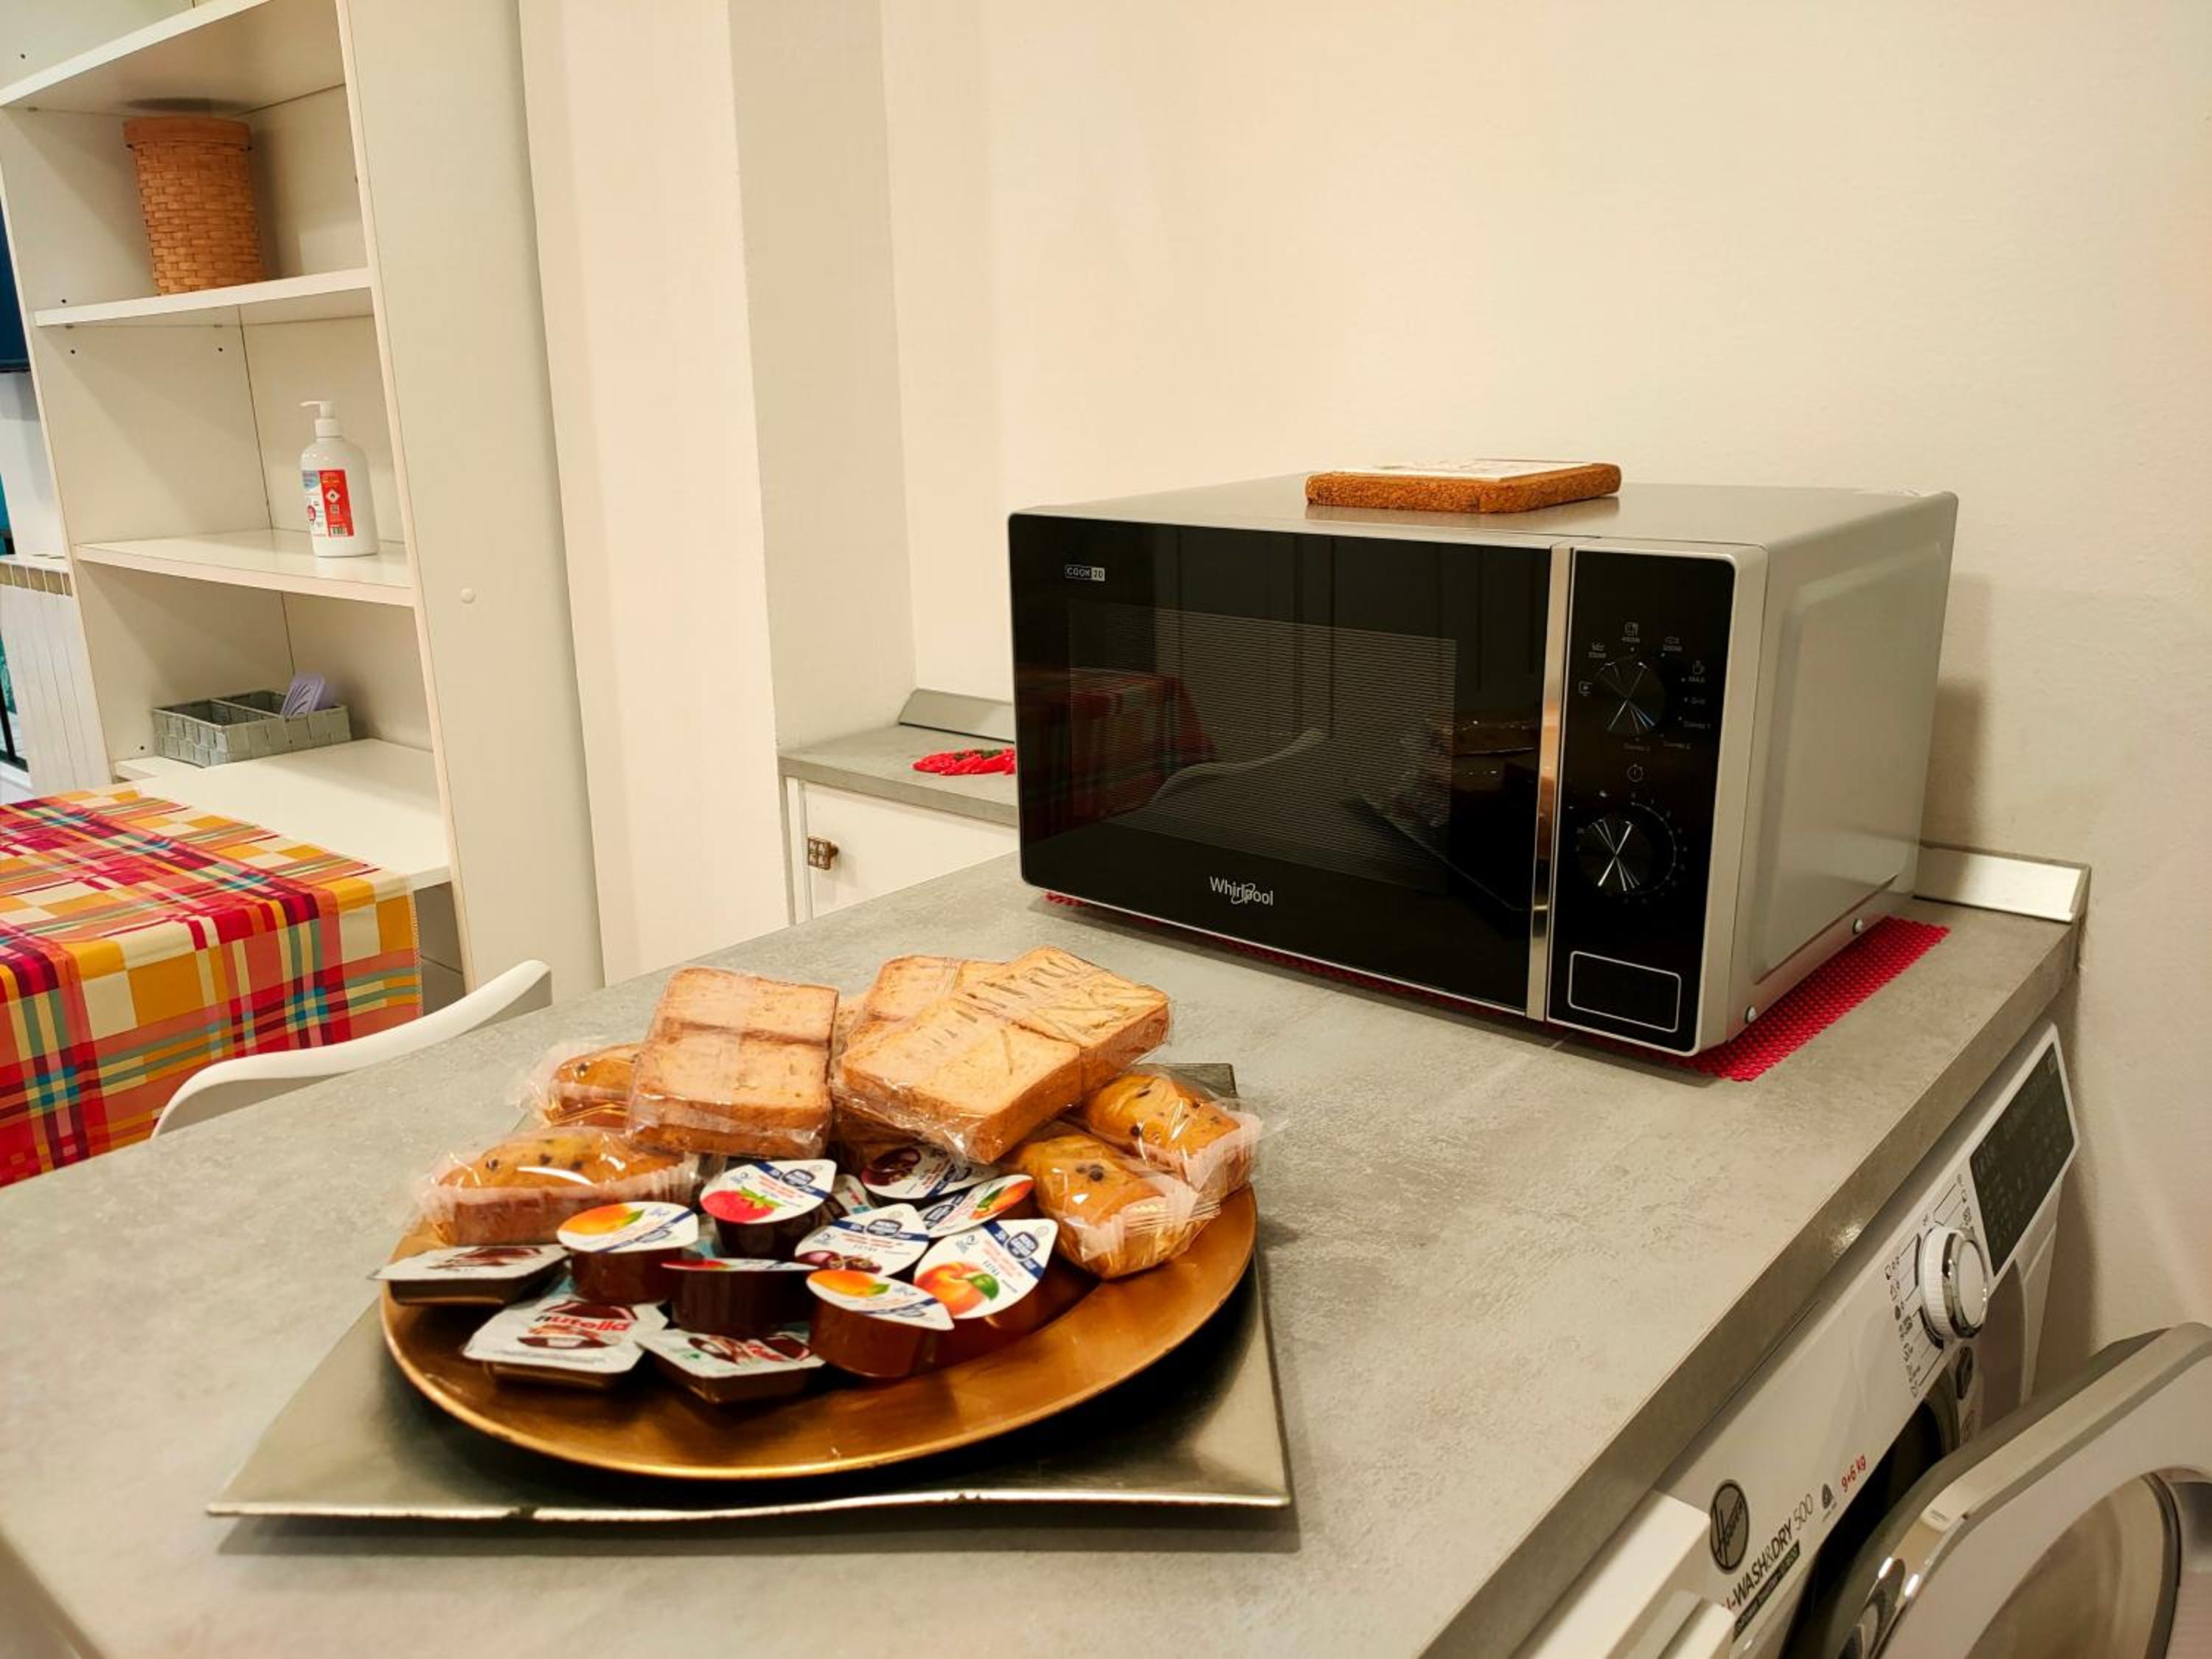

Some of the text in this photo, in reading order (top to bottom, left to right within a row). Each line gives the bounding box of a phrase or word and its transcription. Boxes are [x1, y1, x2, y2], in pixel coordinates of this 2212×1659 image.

[1209, 875, 1273, 906] Whirlpool
[535, 1315, 631, 1331] nutella
[1793, 1493, 1814, 1531] 500
